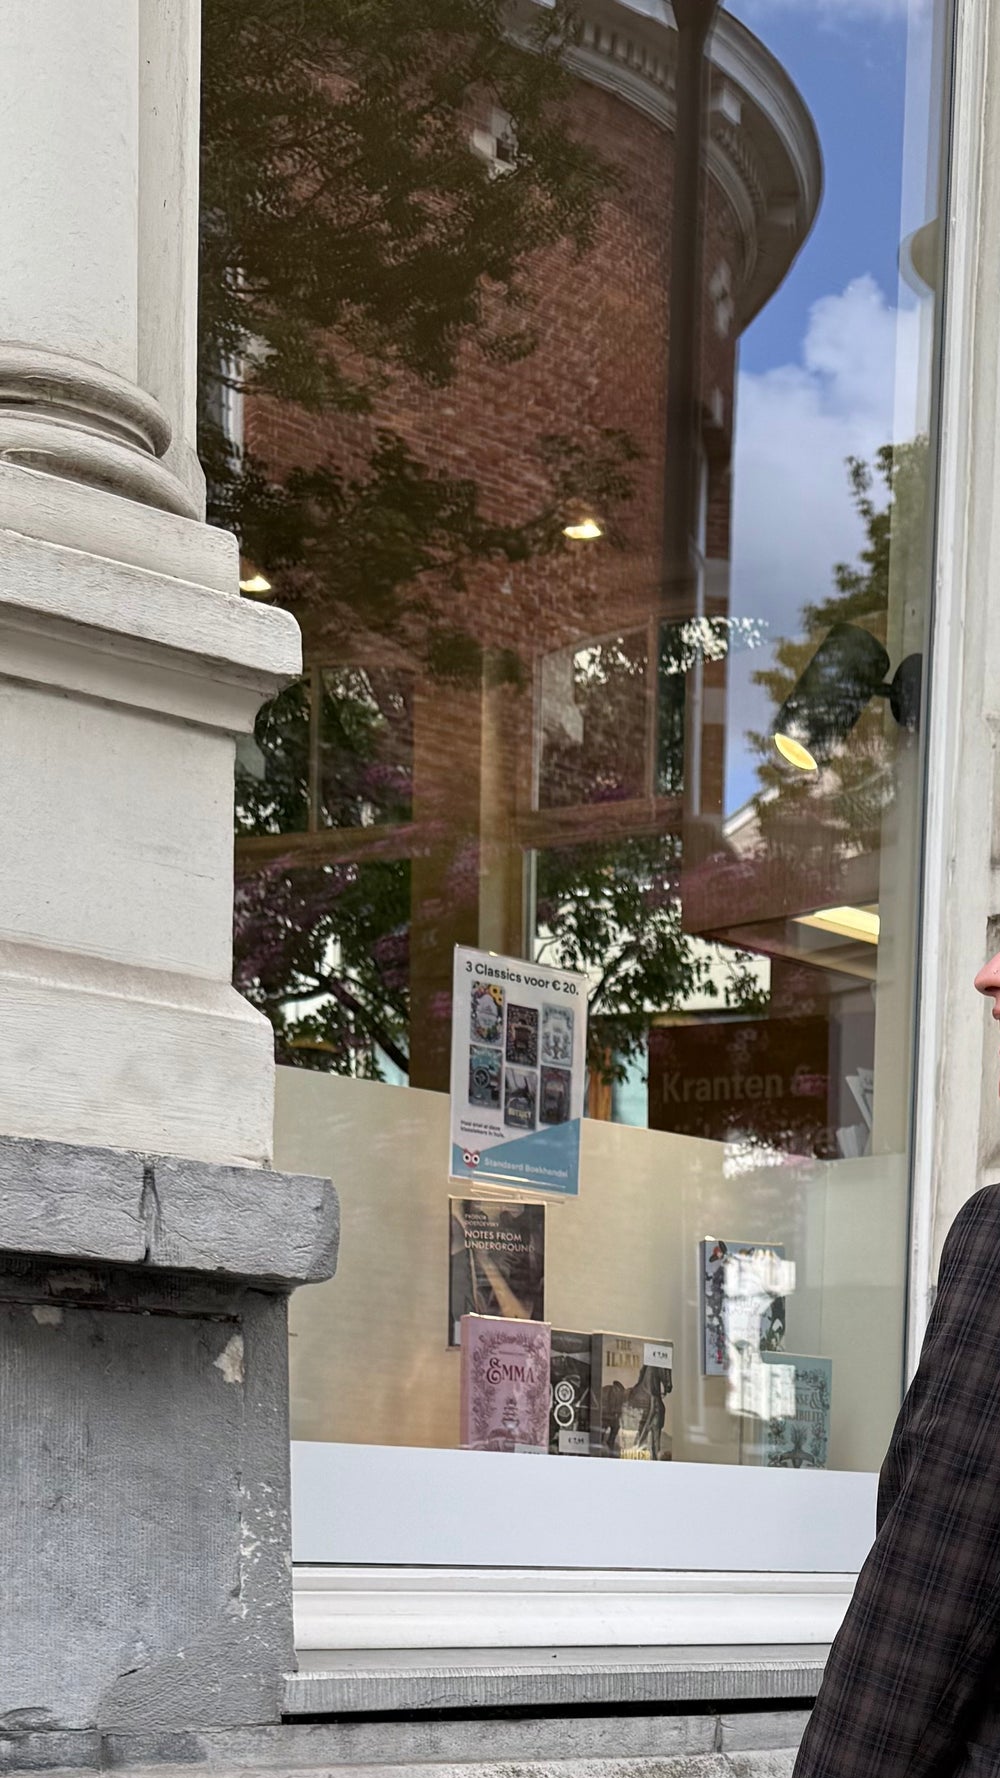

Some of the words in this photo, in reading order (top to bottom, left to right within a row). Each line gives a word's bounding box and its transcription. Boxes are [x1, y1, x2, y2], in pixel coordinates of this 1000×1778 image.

[465, 961, 473, 972] 3
[475, 963, 522, 983] Classics
[524, 976, 550, 989] voor
[552, 980, 561, 991] €
[563, 982, 579, 996] 20.
[662, 1072, 784, 1103] Kranten
[484, 1157, 524, 1171] Standaard
[525, 1164, 569, 1178] Boekhandel
[464, 1230, 494, 1240] NOTES
[496, 1231, 522, 1242] FROM
[464, 1240, 535, 1253] UNDERGROUND
